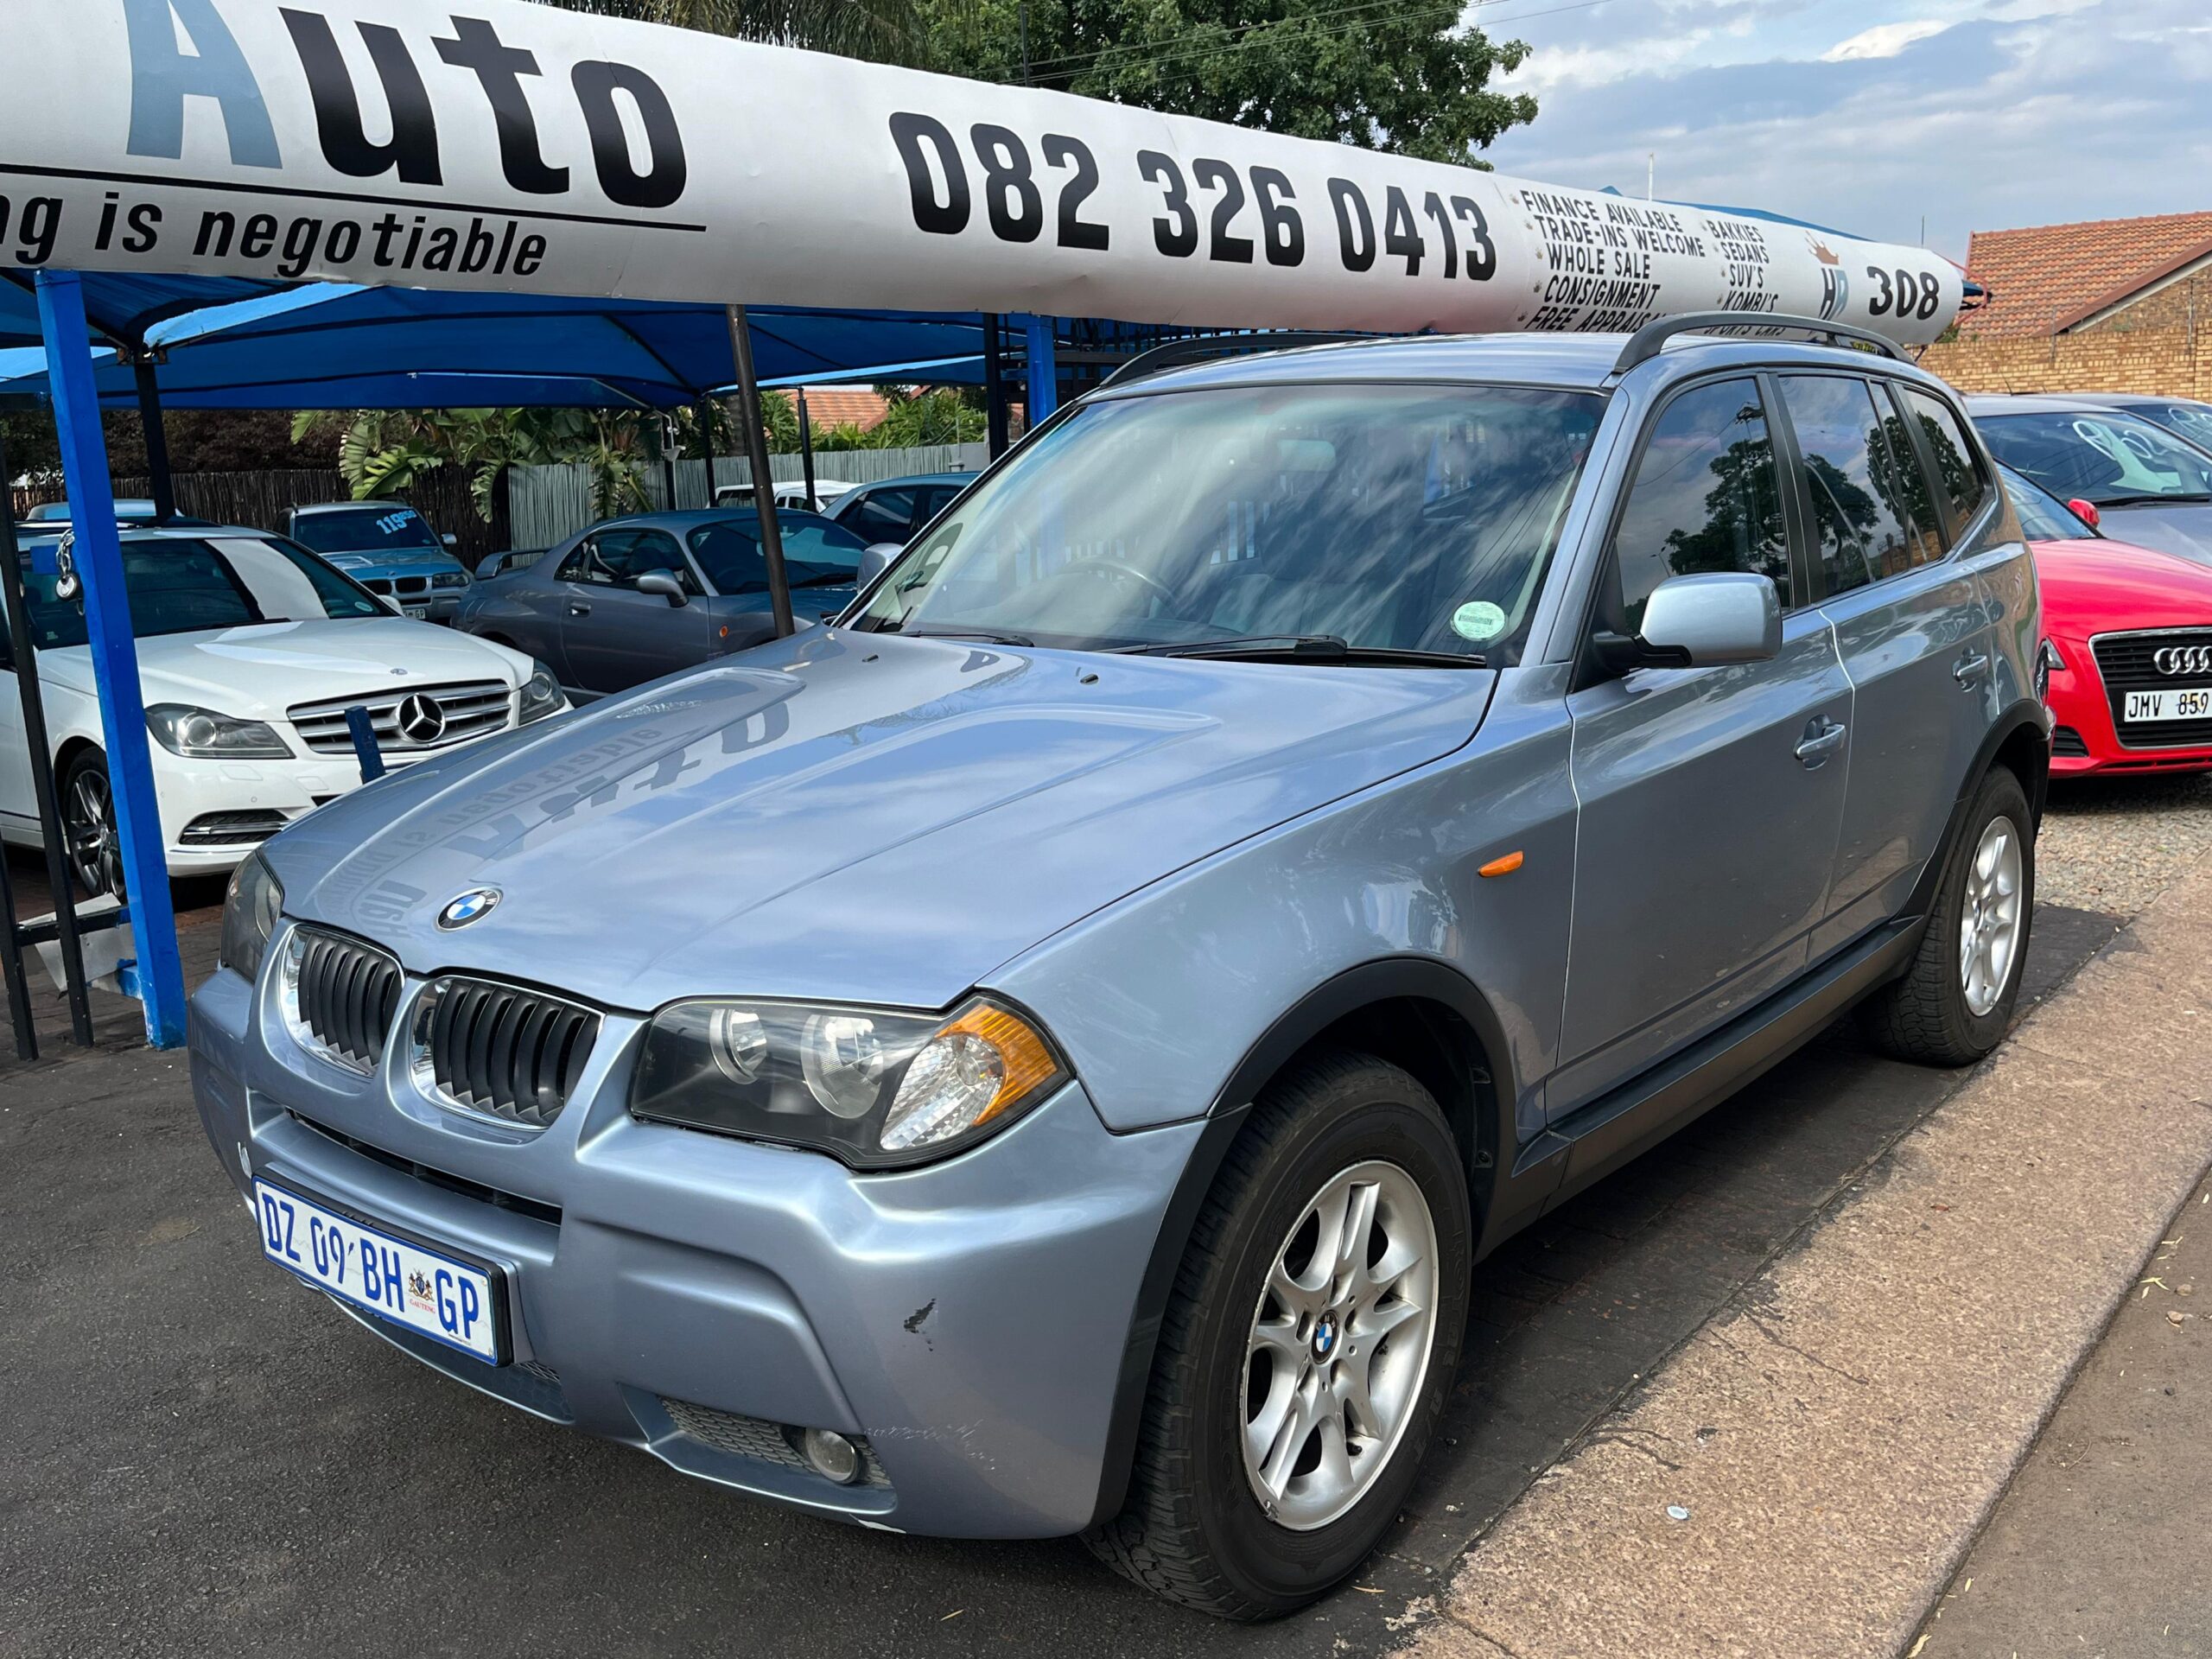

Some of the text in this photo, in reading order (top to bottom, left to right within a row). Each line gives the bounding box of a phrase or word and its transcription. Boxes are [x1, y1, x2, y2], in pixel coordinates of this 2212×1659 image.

[124, 0, 687, 208] Auto
[889, 111, 1497, 282] 082 326 0413
[1520, 190, 1684, 233] FINANCE AVAILABLE
[0, 192, 548, 277] g is negotiable
[1534, 214, 1707, 257] TRADE-INS WELCOME
[1707, 219, 1764, 243] BAKKIES
[1546, 243, 1650, 279] WHOLE SALE
[1720, 242, 1770, 264] SEDANS
[1544, 275, 1661, 309] CONSIGNMENT
[1730, 264, 1764, 289] SUV'S
[1866, 266, 1939, 320] 308
[1524, 306, 1580, 330] FREE
[1721, 290, 1779, 312] KOMBI'S
[2129, 695, 2162, 718] JMV
[262, 1192, 301, 1262] DZ
[360, 1237, 405, 1313] BH
[435, 1268, 480, 1339] GP
[410, 1298, 436, 1314] GAUTENG
